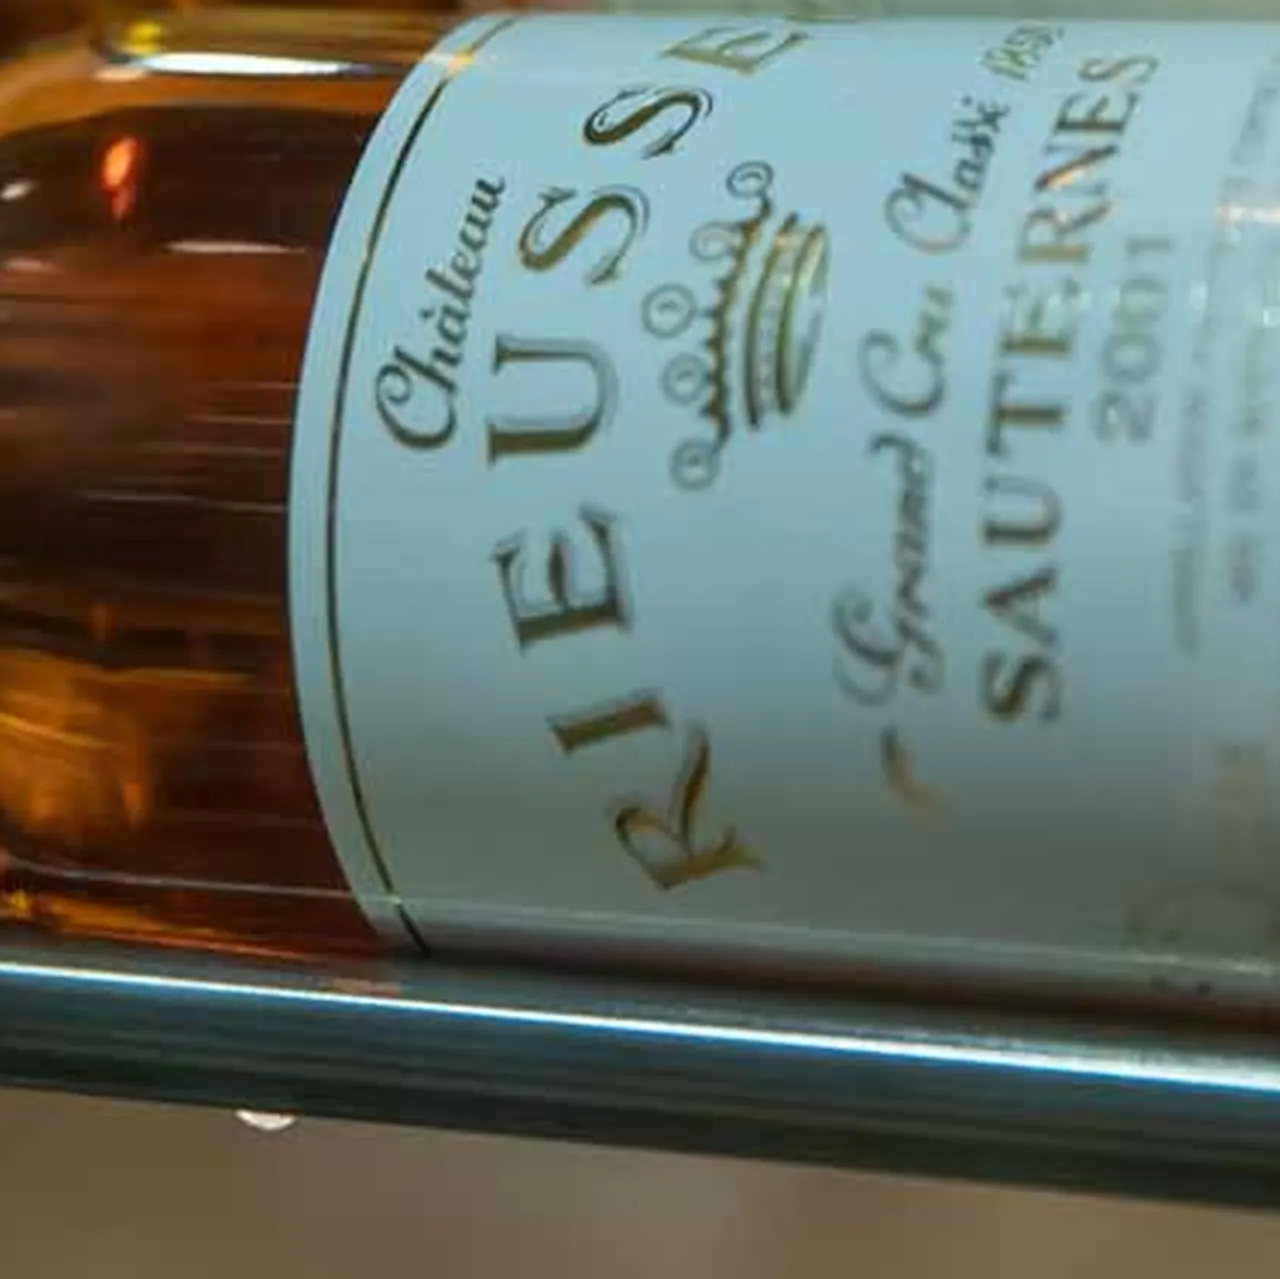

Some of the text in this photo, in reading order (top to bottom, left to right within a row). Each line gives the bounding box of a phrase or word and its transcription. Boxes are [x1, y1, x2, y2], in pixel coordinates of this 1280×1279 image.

[375, 170, 508, 453] Château
[858, 283, 958, 422] Cru
[976, 53, 1162, 726] SAUTERNES
[1086, 232, 1178, 446] 2001
[830, 432, 947, 709] Grand
